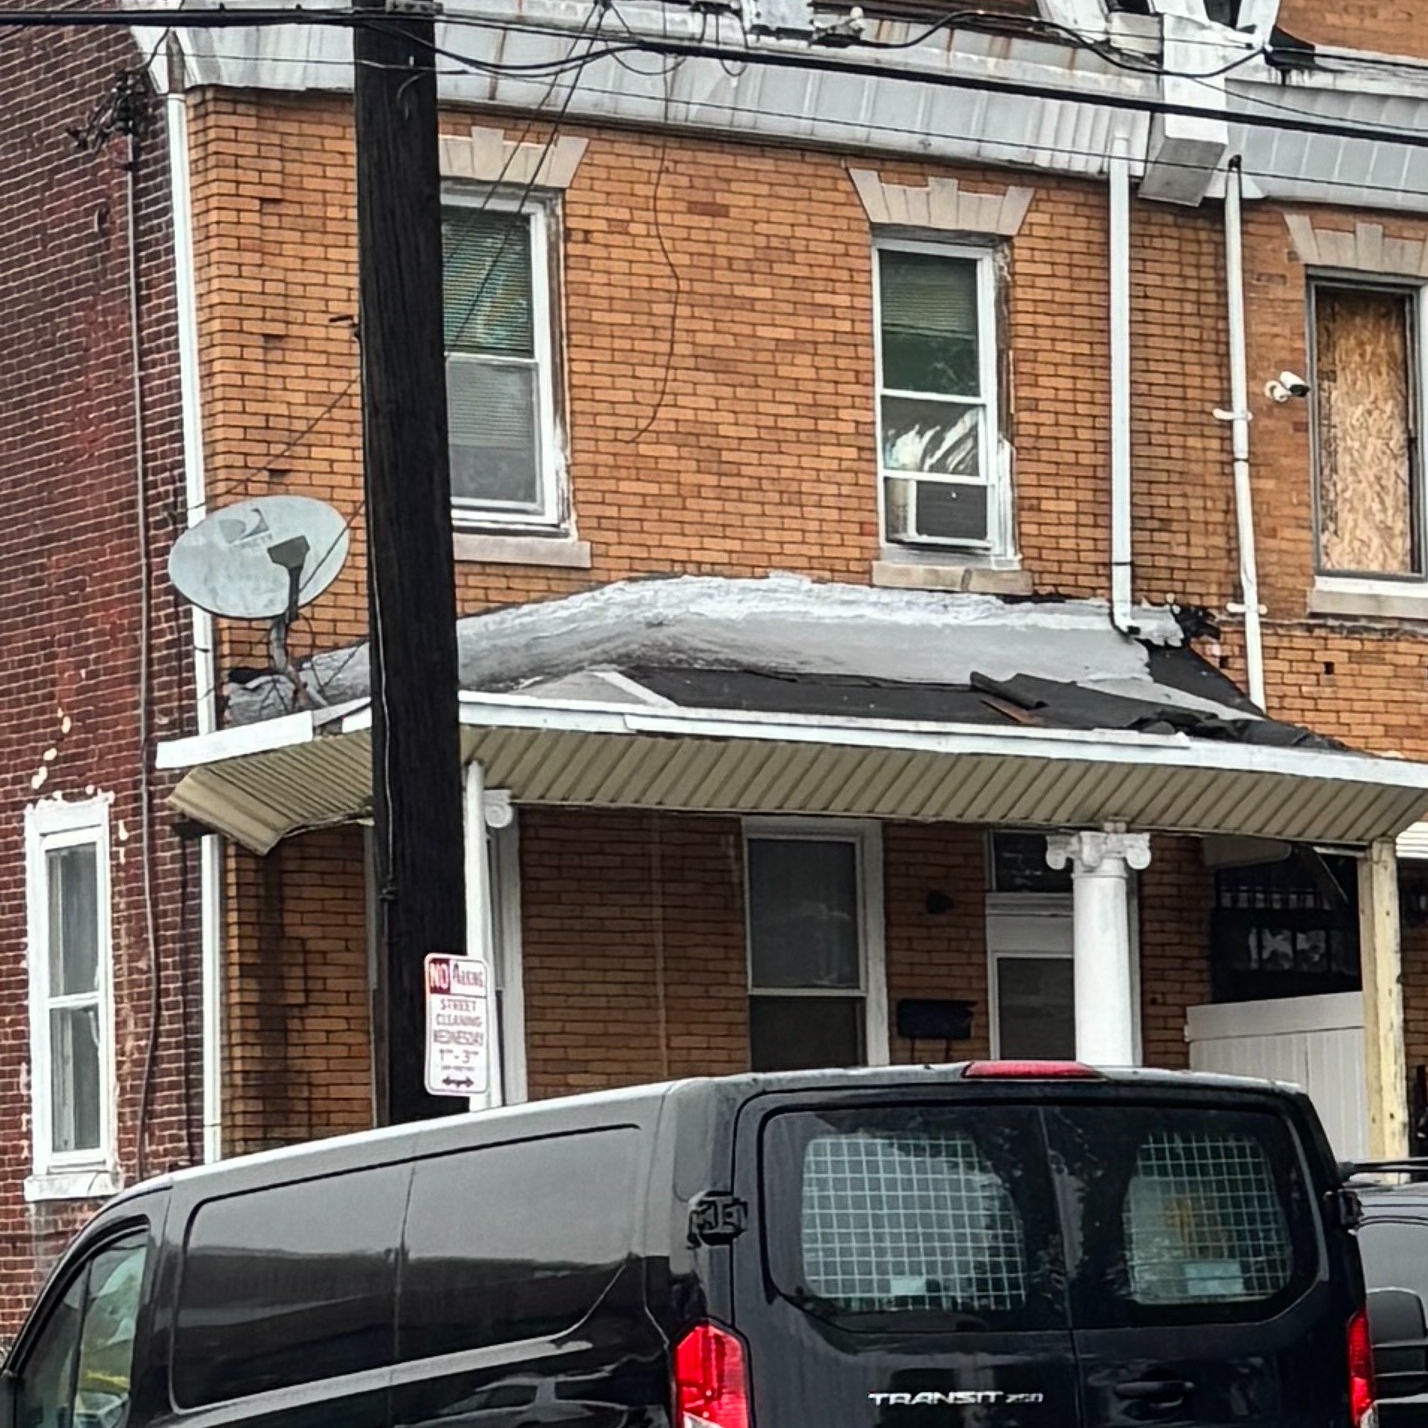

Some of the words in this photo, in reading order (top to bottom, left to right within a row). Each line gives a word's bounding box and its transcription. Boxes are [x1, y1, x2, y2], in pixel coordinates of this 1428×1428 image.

[429, 962, 450, 990] NO
[440, 999, 477, 1012] STREET
[436, 1014, 482, 1027] CLEANING
[868, 1391, 1004, 1406] TRANSIT
